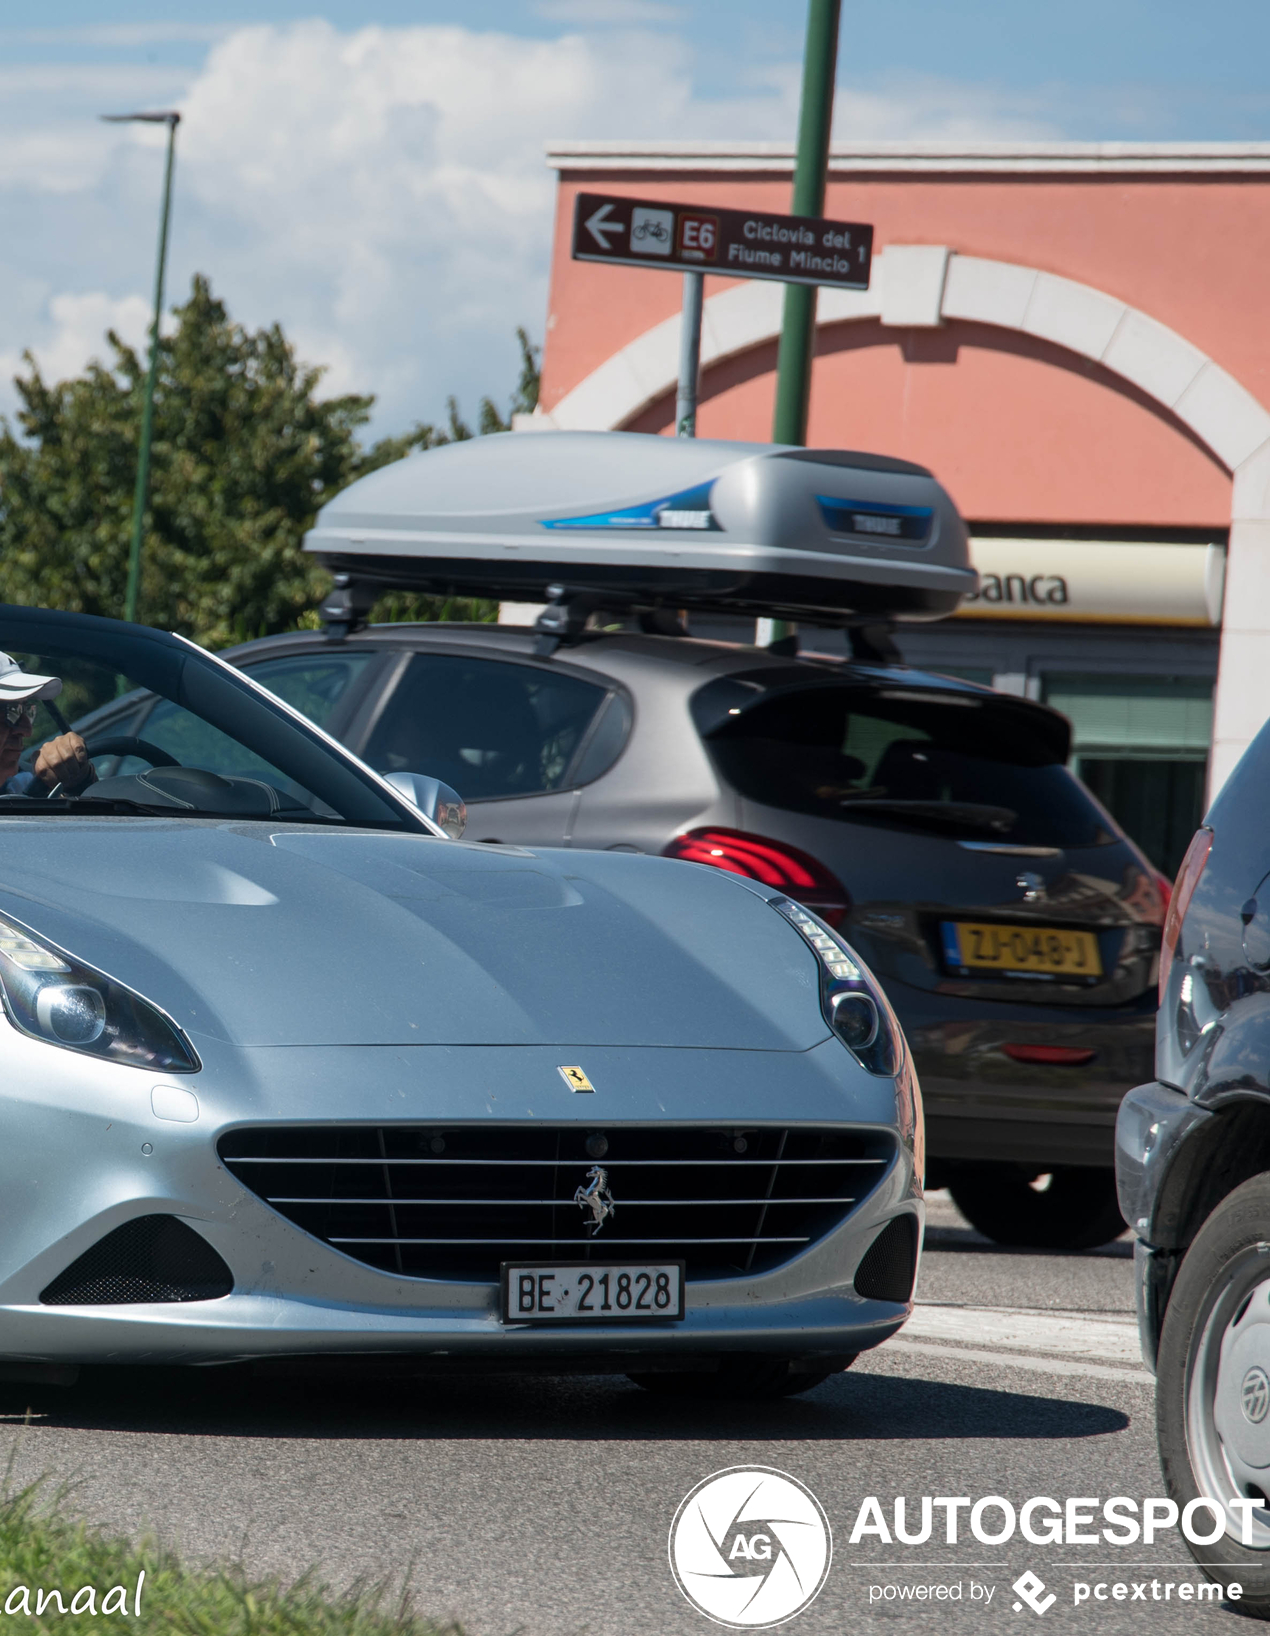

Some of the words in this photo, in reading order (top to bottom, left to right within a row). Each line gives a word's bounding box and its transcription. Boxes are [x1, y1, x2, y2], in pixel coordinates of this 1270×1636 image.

[683, 221, 714, 249] E6
[743, 220, 815, 245] Ciclovia
[823, 230, 851, 249] del
[728, 243, 783, 266] Fiume
[790, 250, 850, 273] Mincio
[857, 245, 867, 263] 1
[966, 573, 1068, 605] anca
